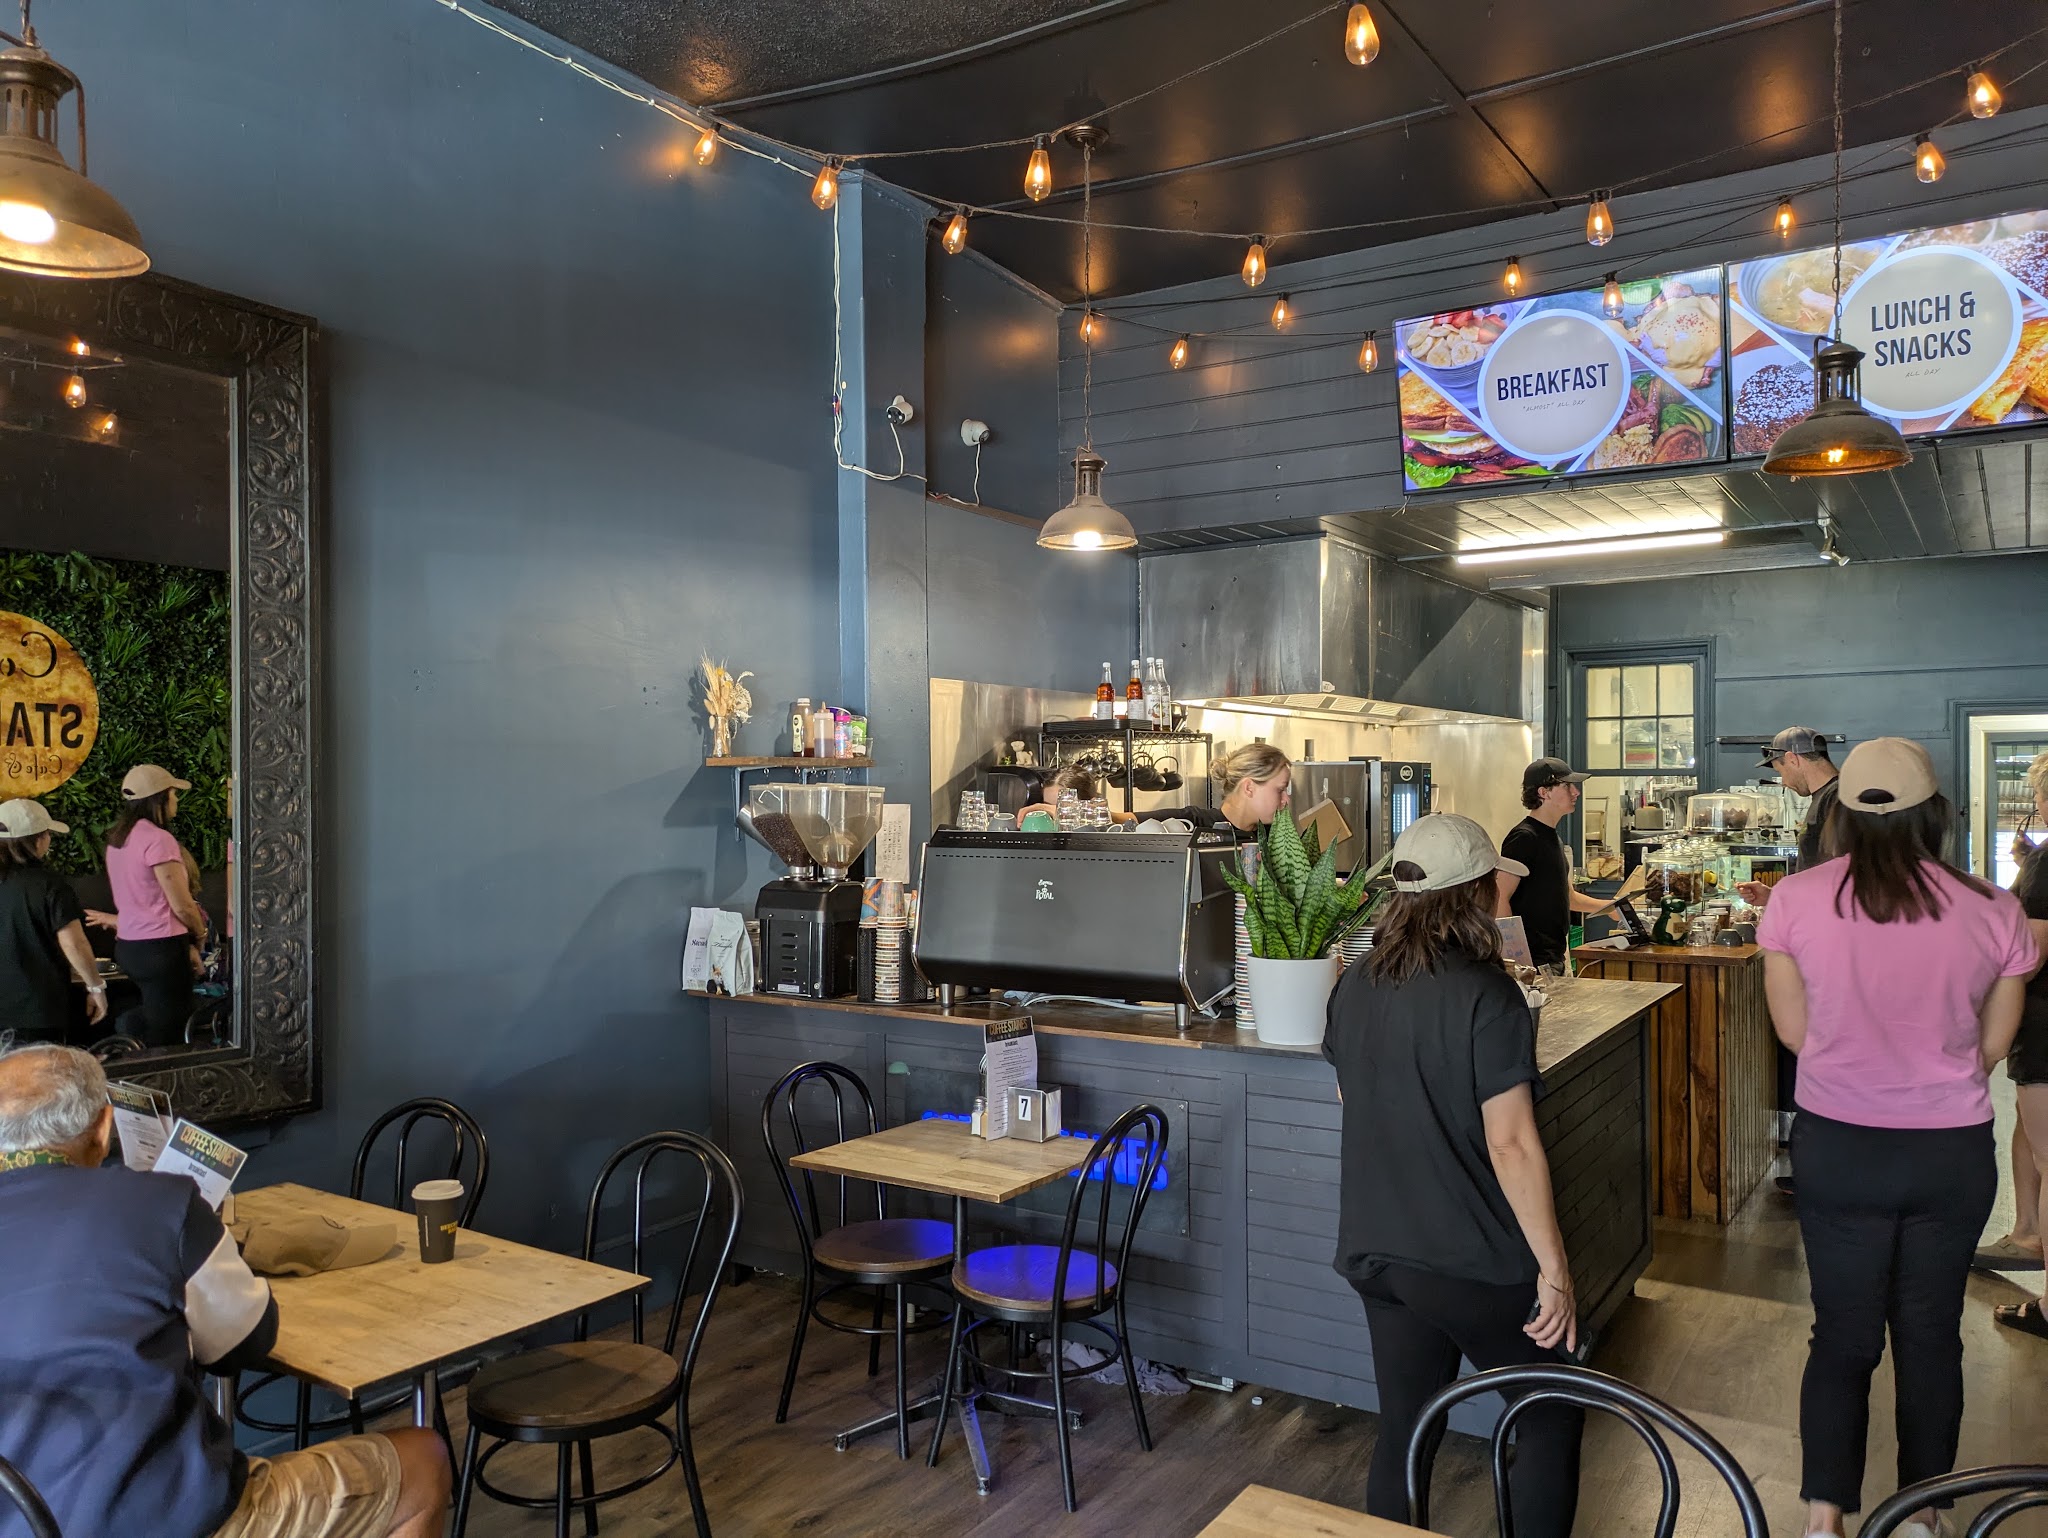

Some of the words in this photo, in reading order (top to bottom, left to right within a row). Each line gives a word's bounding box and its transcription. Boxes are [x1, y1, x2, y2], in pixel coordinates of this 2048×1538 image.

[1871, 294, 1951, 332] LUNCH
[1959, 291, 1976, 319] &
[1874, 329, 1972, 367] SNACKS
[1497, 363, 1609, 401] BREAKFAST
[1020, 1098, 1029, 1118] 7
